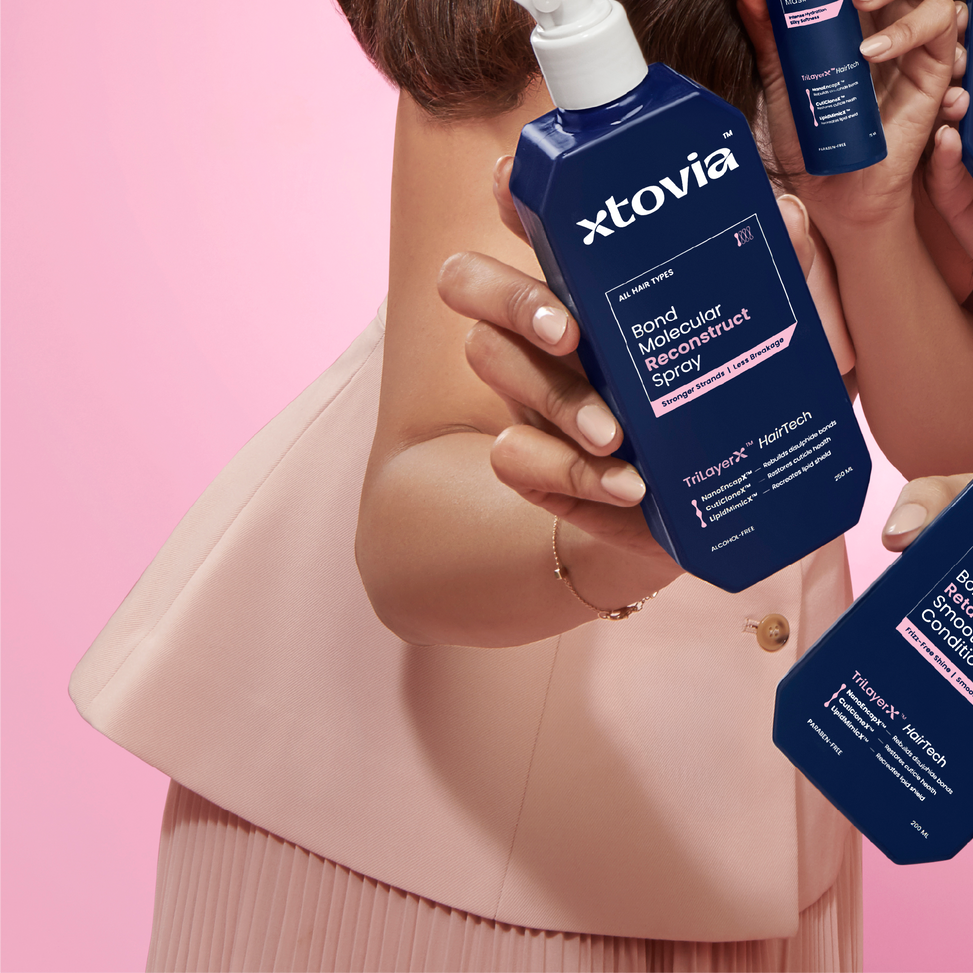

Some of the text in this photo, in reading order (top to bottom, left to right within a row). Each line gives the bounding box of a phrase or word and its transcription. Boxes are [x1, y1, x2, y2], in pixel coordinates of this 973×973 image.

[835, 61, 860, 74] HairTech
[618, 268, 674, 302] ALL HAIR TYPES
[631, 305, 678, 339] Bond
[638, 304, 722, 355] Molecular
[644, 308, 751, 371] Reconstruct
[652, 354, 701, 387] Spray
[661, 386, 695, 407] Stronger
[695, 371, 725, 390] Strands
[732, 357, 750, 370] Less
[749, 337, 784, 361] Breakage
[758, 411, 812, 449] HairTech
[763, 450, 789, 468] Rebuilds
[788, 432, 818, 454] disulphide
[818, 420, 837, 435] bonds
[767, 461, 793, 479] Restores
[792, 448, 813, 464] cuticle
[812, 436, 832, 451] health
[771, 470, 802, 490] Recreates
[801, 460, 815, 473] lipid
[814, 450, 832, 465] shield
[833, 471, 845, 482] 250
[711, 525, 755, 552] ALCOHOL-FREE
[905, 627, 934, 656] Frizz-Free
[933, 654, 951, 673] Shine
[807, 718, 843, 756] PARABEN-FREE
[902, 724, 947, 768] HairTech
[875, 752, 901, 777] Recreates
[909, 785, 926, 802] shield
[884, 744, 905, 766] Restores
[904, 764, 921, 781] cuticle
[920, 778, 937, 795] health
[891, 735, 914, 758] Rebuilds
[935, 777, 954, 795] bonds
[910, 820, 929, 839] 200 ML
